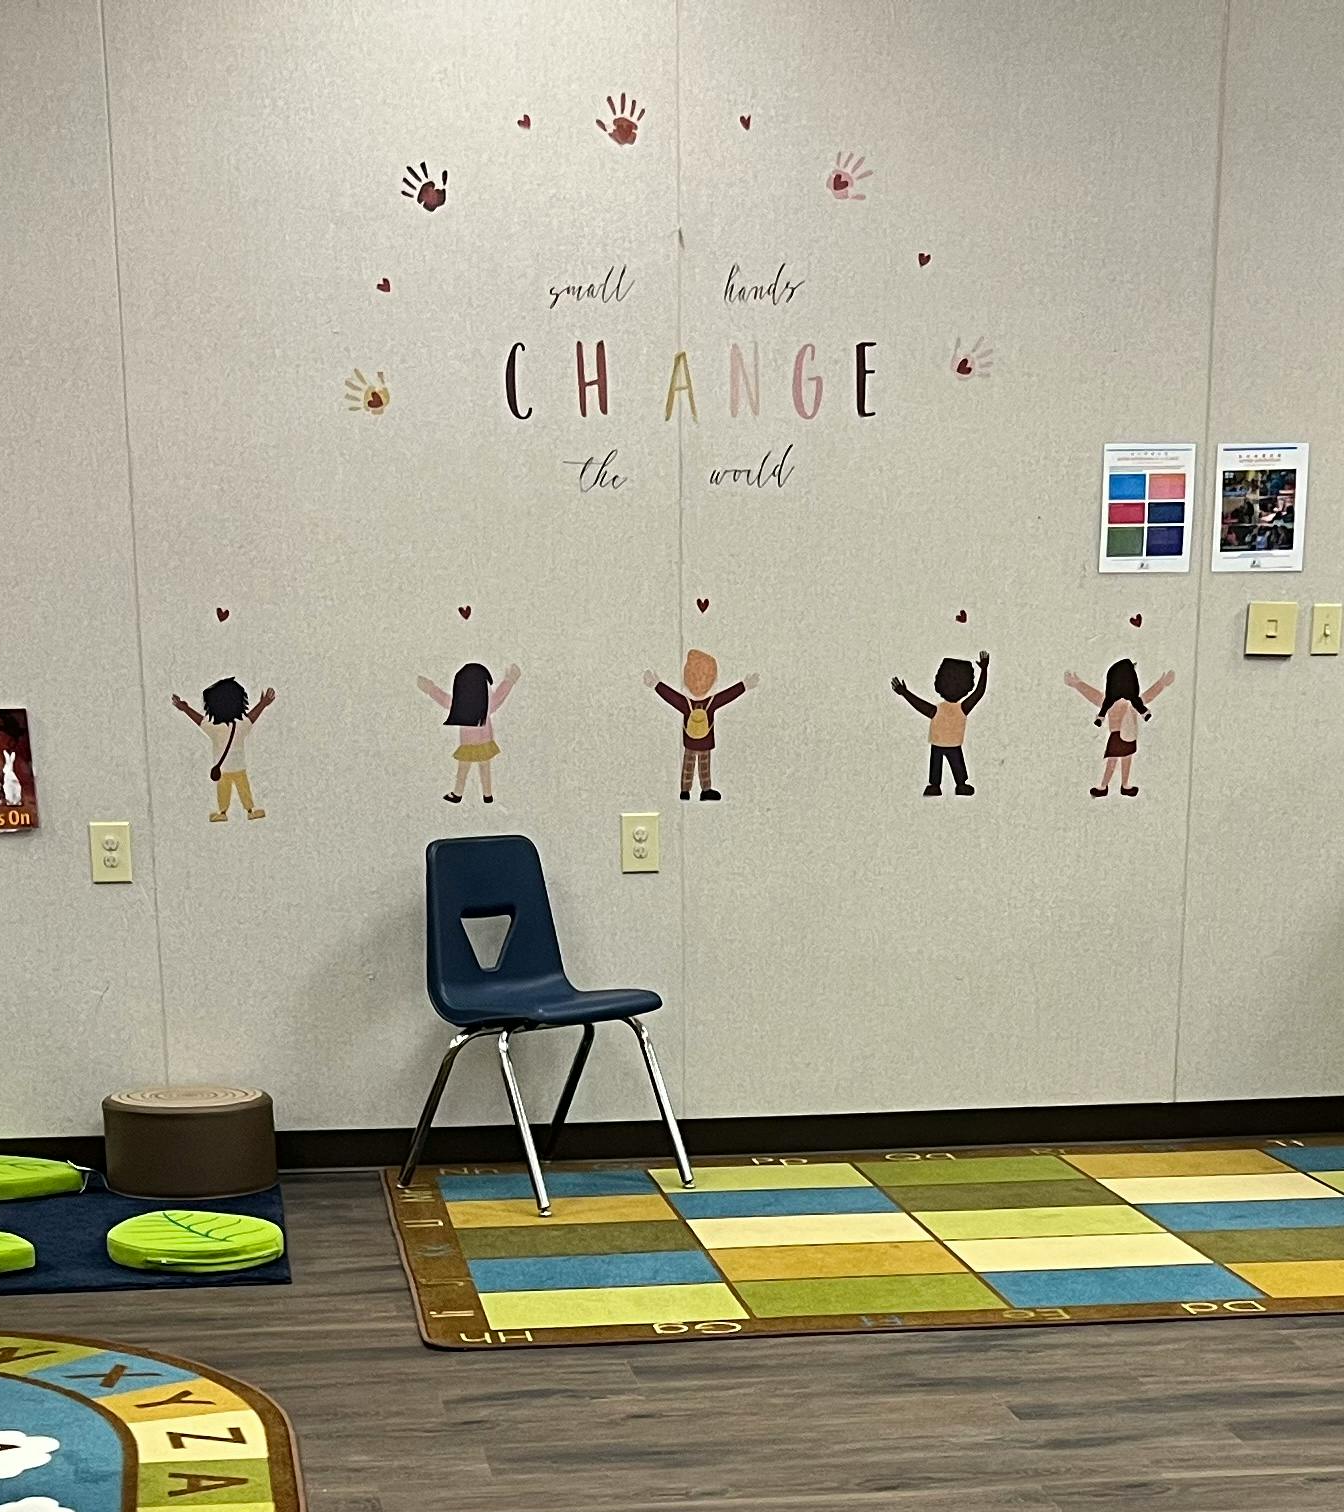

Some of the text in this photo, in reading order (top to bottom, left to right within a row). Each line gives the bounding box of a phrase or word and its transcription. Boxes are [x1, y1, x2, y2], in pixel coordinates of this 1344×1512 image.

[549, 262, 806, 309] small hands
[505, 340, 877, 422] CHANGE
[563, 444, 795, 492] the world
[9, 810, 31, 825] On
[65, 1364, 163, 1388] X
[135, 1390, 217, 1409] Y
[166, 1426, 248, 1450] Z
[167, 1472, 249, 1498] A
